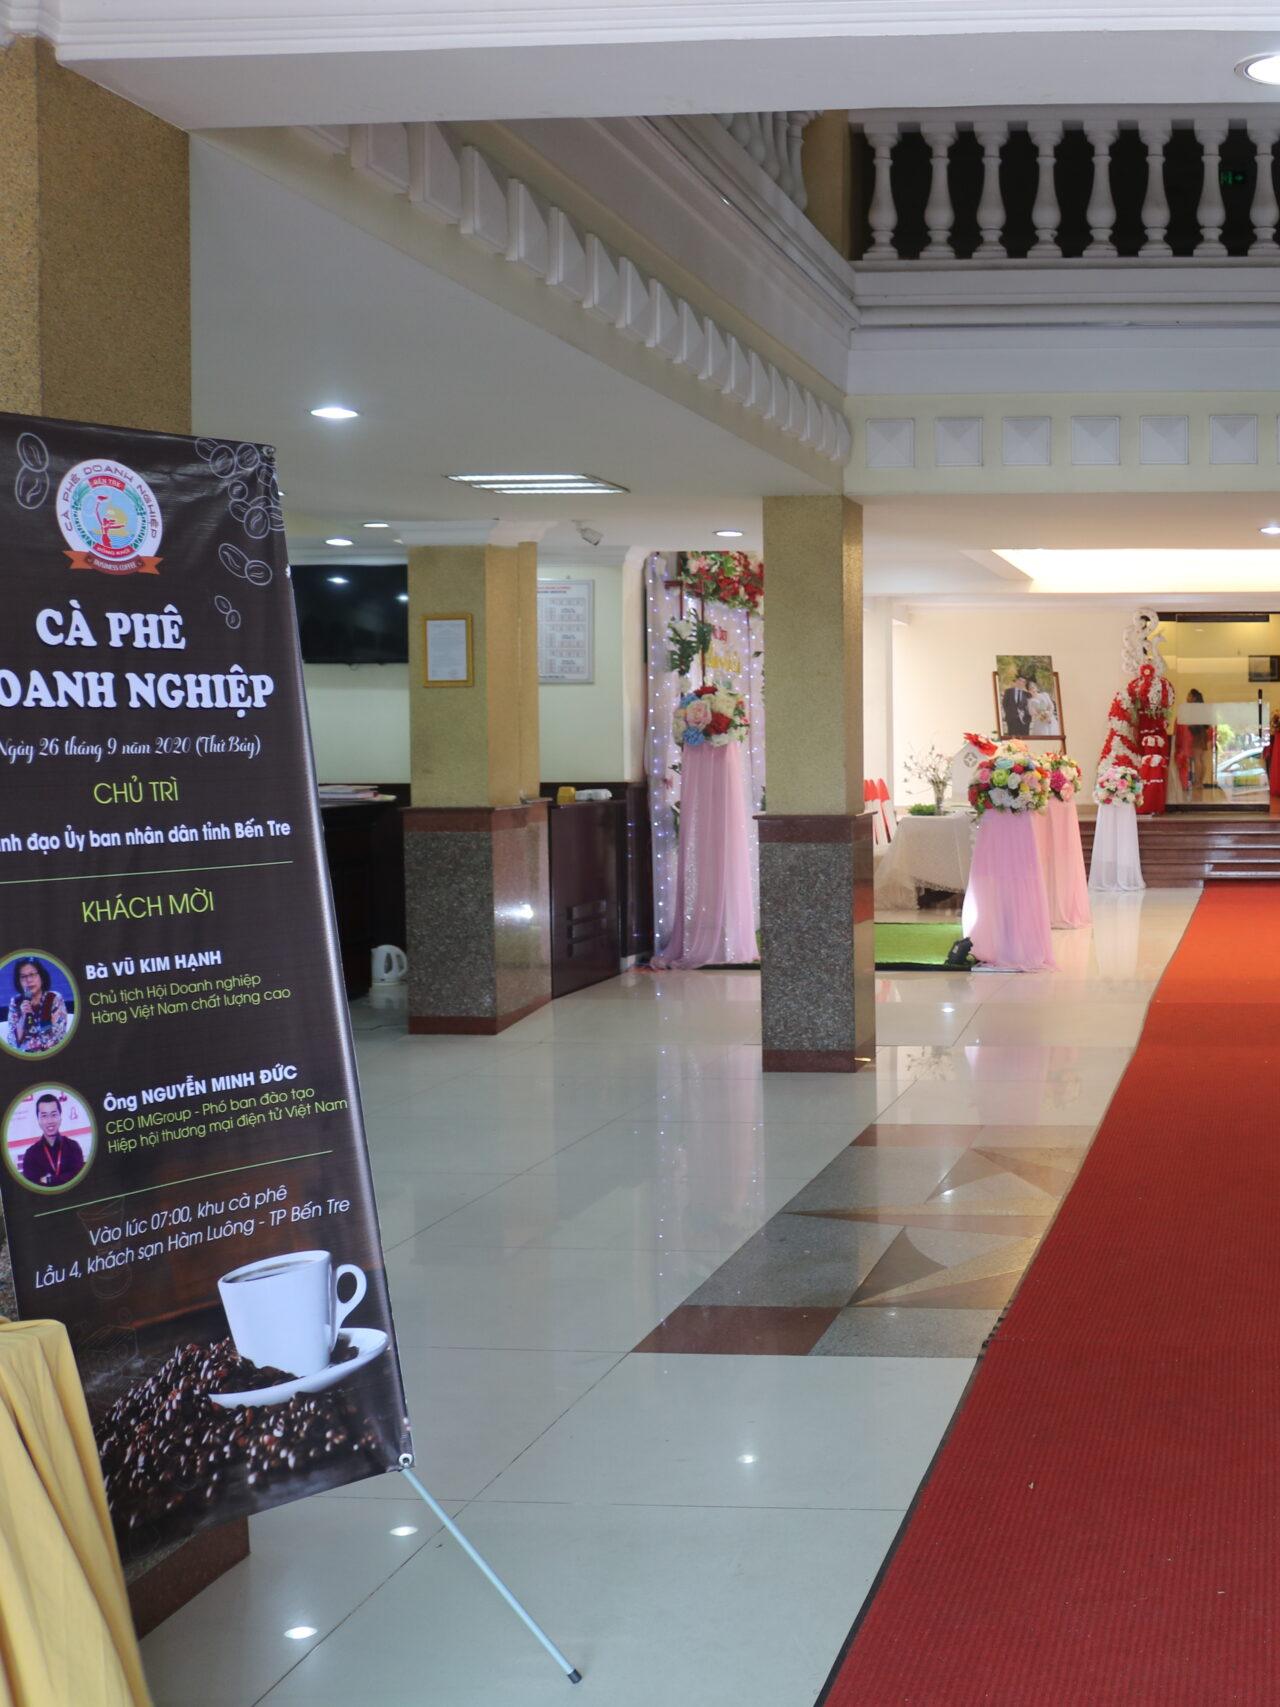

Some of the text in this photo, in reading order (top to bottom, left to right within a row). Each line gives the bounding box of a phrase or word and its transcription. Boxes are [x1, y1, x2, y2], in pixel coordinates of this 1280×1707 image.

[83, 464, 134, 482] DOANH
[35, 599, 187, 650] CÀ PHÊ
[125, 664, 275, 719] NGHIỆP
[39, 737, 59, 756] 26
[65, 735, 103, 763] tháng
[107, 737, 117, 756] 9
[122, 739, 151, 755] năm
[155, 736, 191, 754] 2020
[93, 775, 179, 804] CHỦ TRÌ
[0, 818, 291, 856] nh đạo Ủy ban nhân dân tỉnh Bến Tre
[82, 887, 215, 923] KHÁCH MỜI
[85, 950, 222, 981] Bà VŨ KIM HẠNH
[89, 973, 262, 1007] Chủ tịch Hội Doanh nghiệp
[92, 987, 292, 1025] Hàng Việt Nam chất lượng cao
[103, 1063, 299, 1113] Ông NGUYỄN MINH ĐỨC
[105, 1117, 135, 1136] CEO
[137, 1107, 193, 1131] IMGroup
[202, 1100, 227, 1117] Phó
[230, 1096, 256, 1111] ban
[259, 1089, 289, 1106] đào
[291, 1086, 315, 1102] tạo
[107, 1097, 349, 1155] Hiệp hội thương mại điện tử Việt Nam
[89, 1184, 288, 1247] Vào lúc 07:00, khu cà phê
[34, 1263, 66, 1290] Lầu
[68, 1260, 83, 1280] 4,
[86, 1247, 136, 1275] khách
[138, 1239, 164, 1262] sạn
[167, 1228, 204, 1252] Hàm
[207, 1215, 256, 1243] Luông
[269, 1208, 288, 1229] TP
[290, 1200, 323, 1223] Bến
[326, 1196, 352, 1215] Tre
